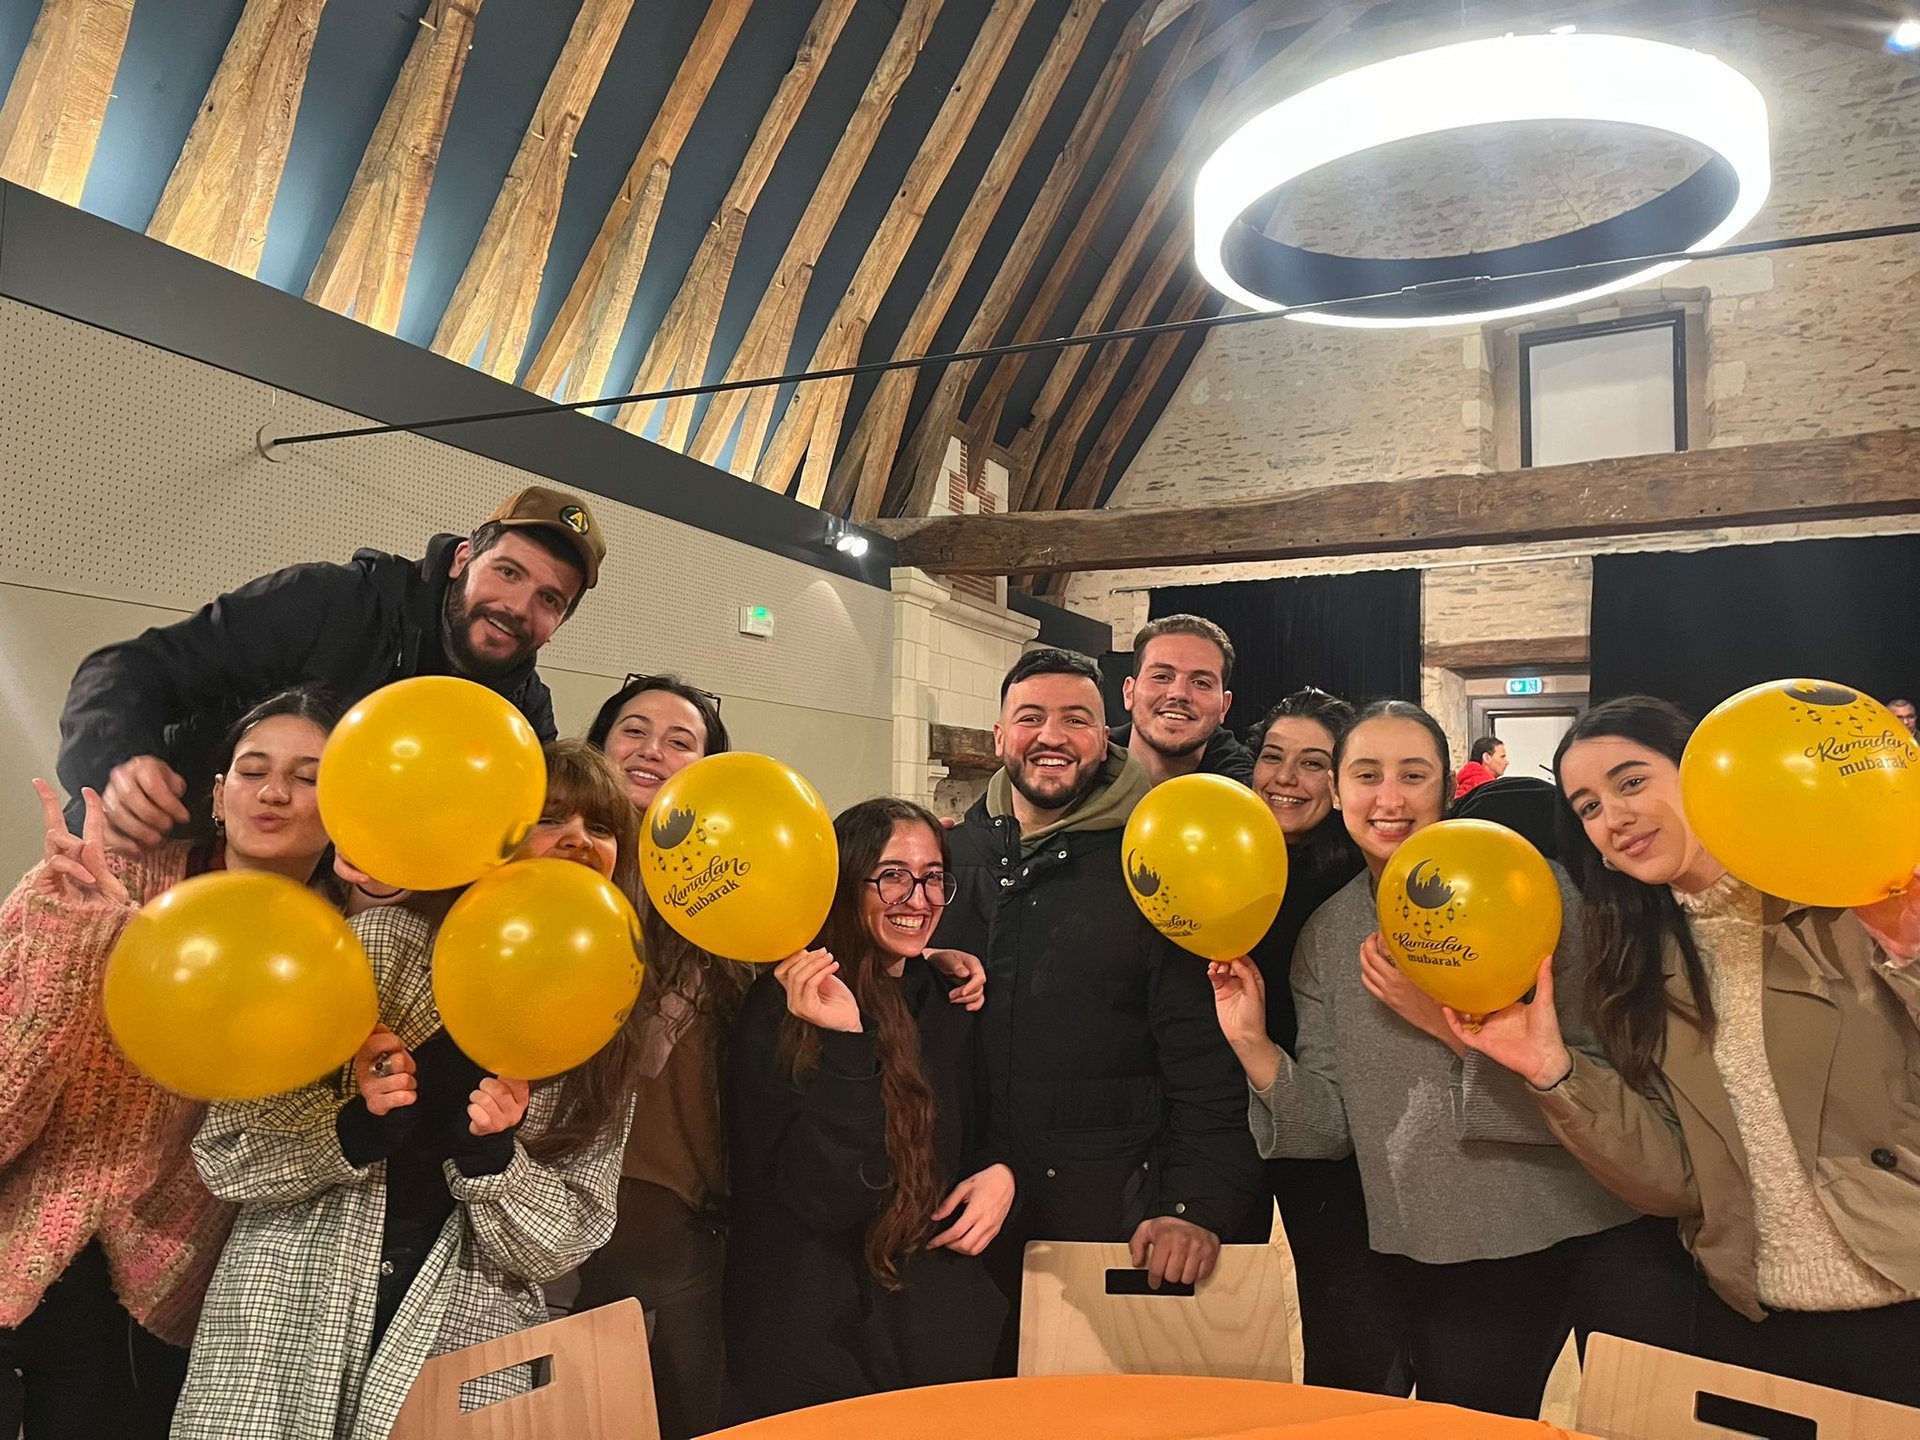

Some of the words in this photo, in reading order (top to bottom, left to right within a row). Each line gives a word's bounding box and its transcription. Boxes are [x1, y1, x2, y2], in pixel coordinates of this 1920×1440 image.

[1804, 730, 1918, 762] Ramadan
[1838, 755, 1908, 777] mubarak
[663, 856, 751, 908] Ramadan
[685, 879, 741, 918] mubarak
[1392, 932, 1479, 961] Ramadan
[1407, 954, 1461, 968] mubarak
